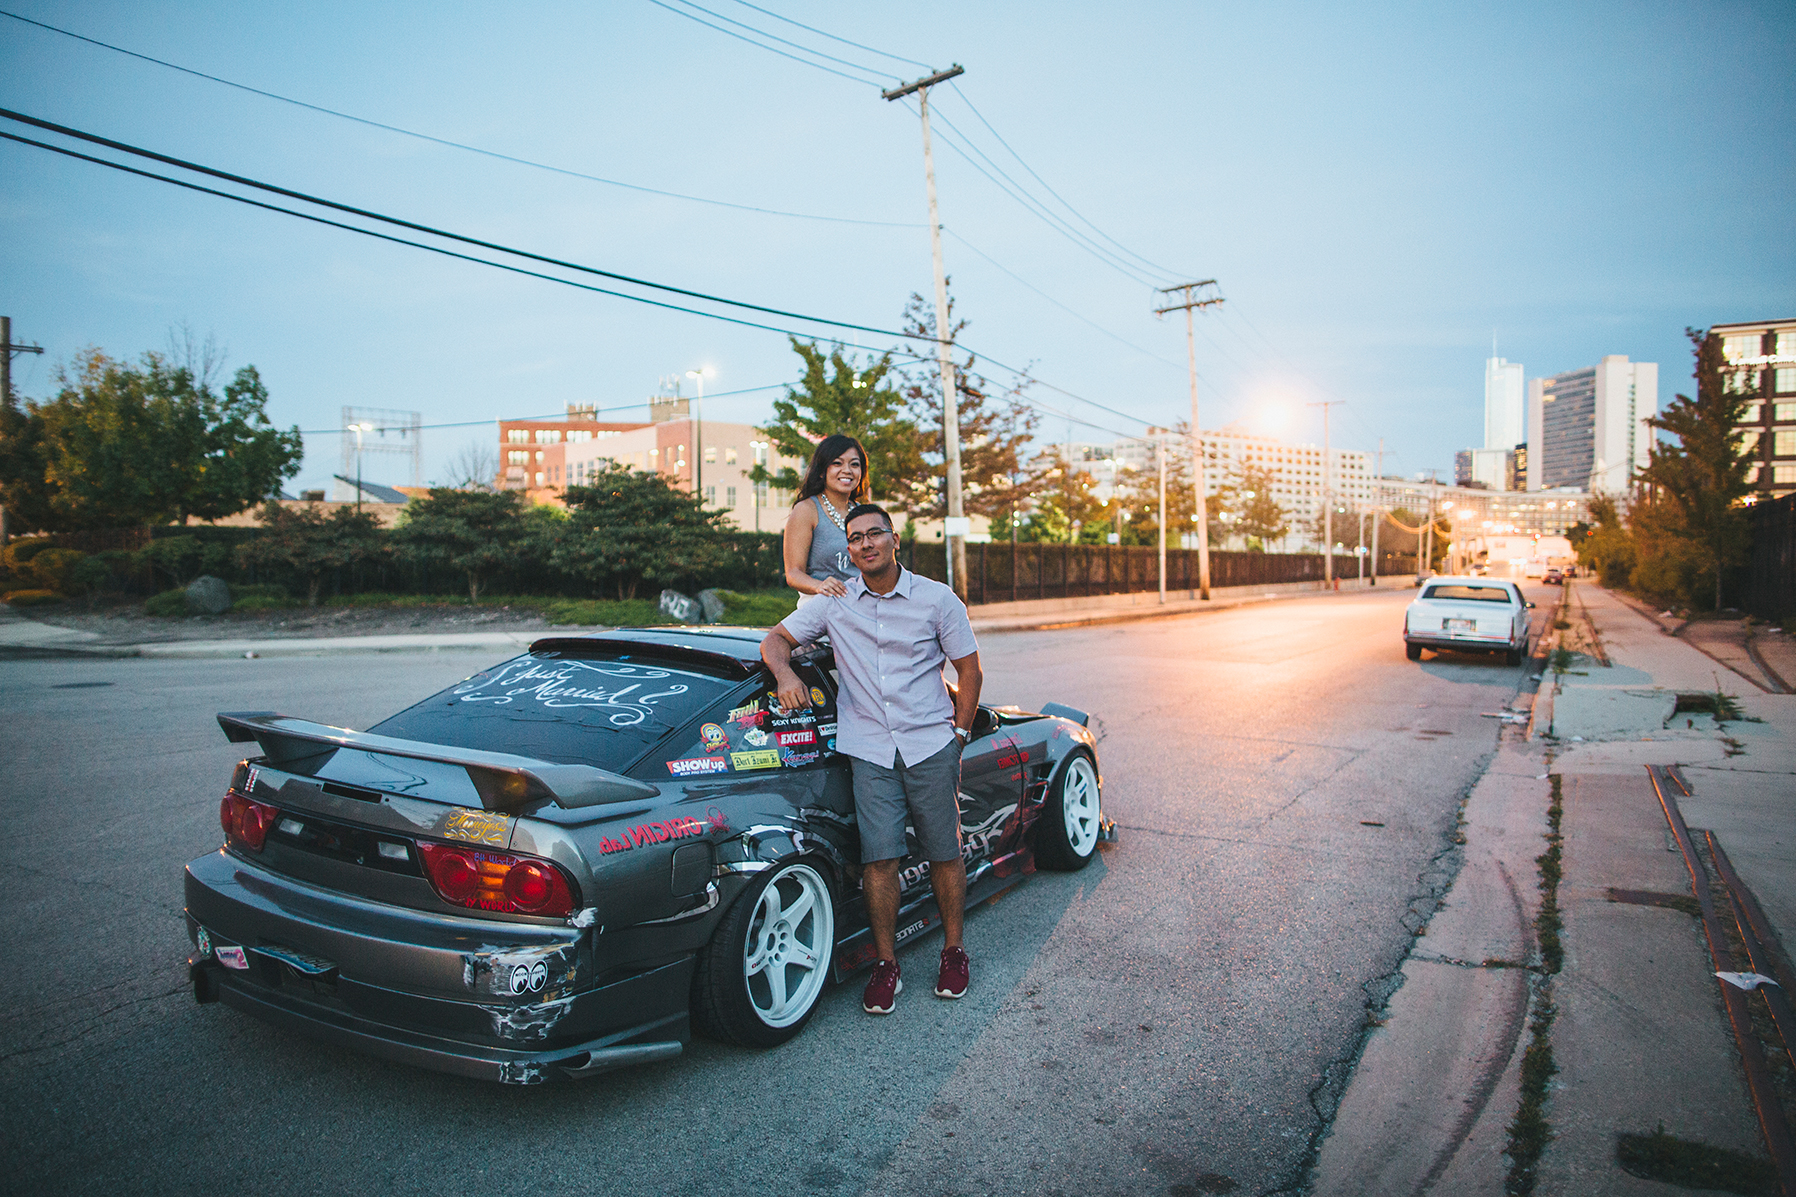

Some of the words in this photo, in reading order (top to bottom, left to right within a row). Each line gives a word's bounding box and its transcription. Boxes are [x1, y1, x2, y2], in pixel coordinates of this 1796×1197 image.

[501, 663, 581, 686] Just
[506, 679, 642, 704] Married
[780, 731, 813, 745] EXCITE!
[479, 898, 517, 913] WORLD
